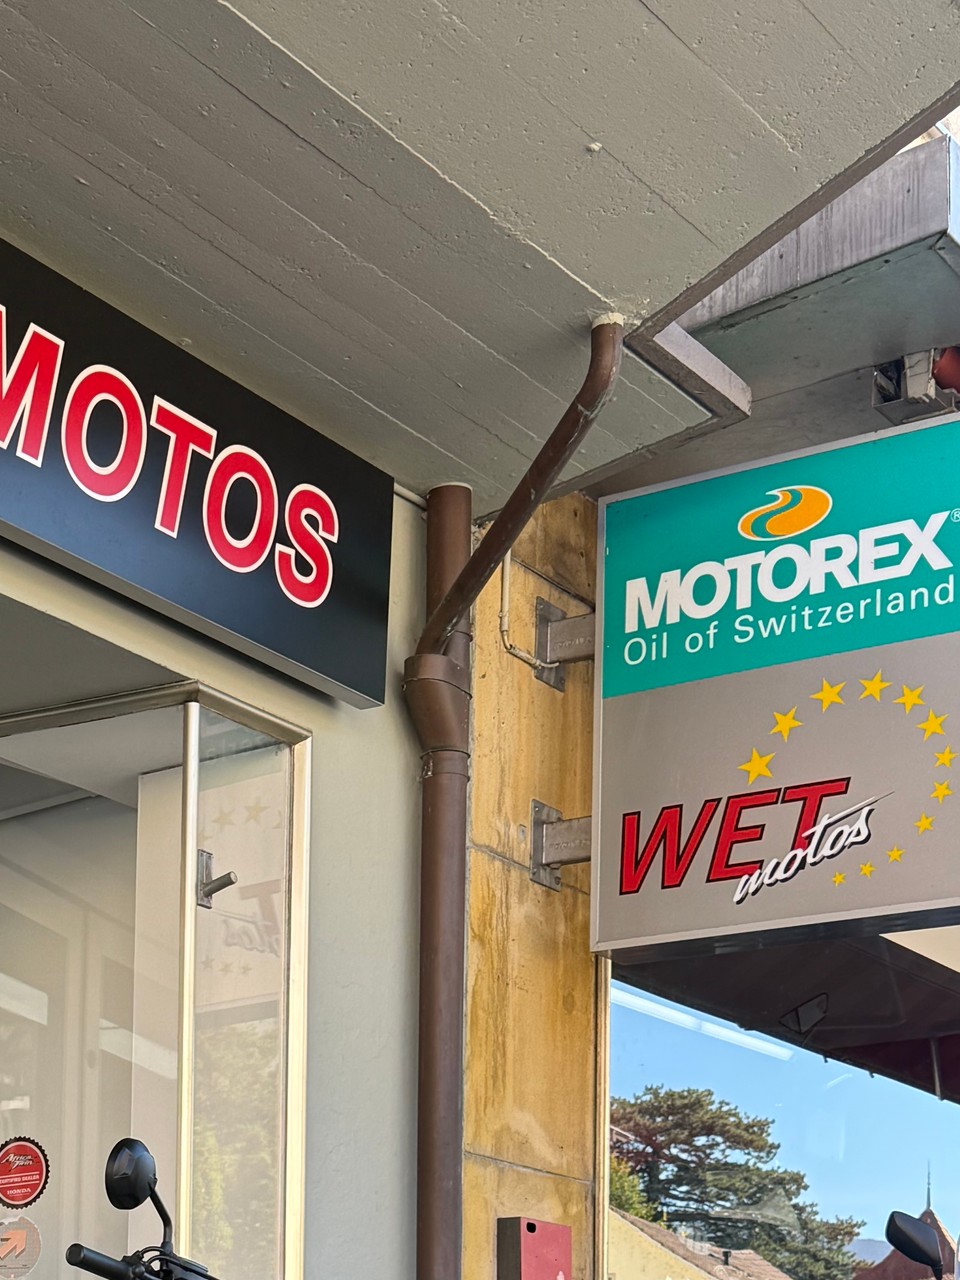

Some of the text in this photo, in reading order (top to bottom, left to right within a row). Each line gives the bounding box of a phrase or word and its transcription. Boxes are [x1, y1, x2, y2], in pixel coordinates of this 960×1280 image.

[623, 630, 668, 667] Oil
[685, 621, 719, 654] of
[733, 574, 954, 644] Switzerland
[625, 510, 954, 634] MOTOREX
[618, 776, 852, 896] WET
[733, 791, 895, 906] motos
[7, 1187, 32, 1196] HONDA
[21, 1174, 40, 1183] DEALER
